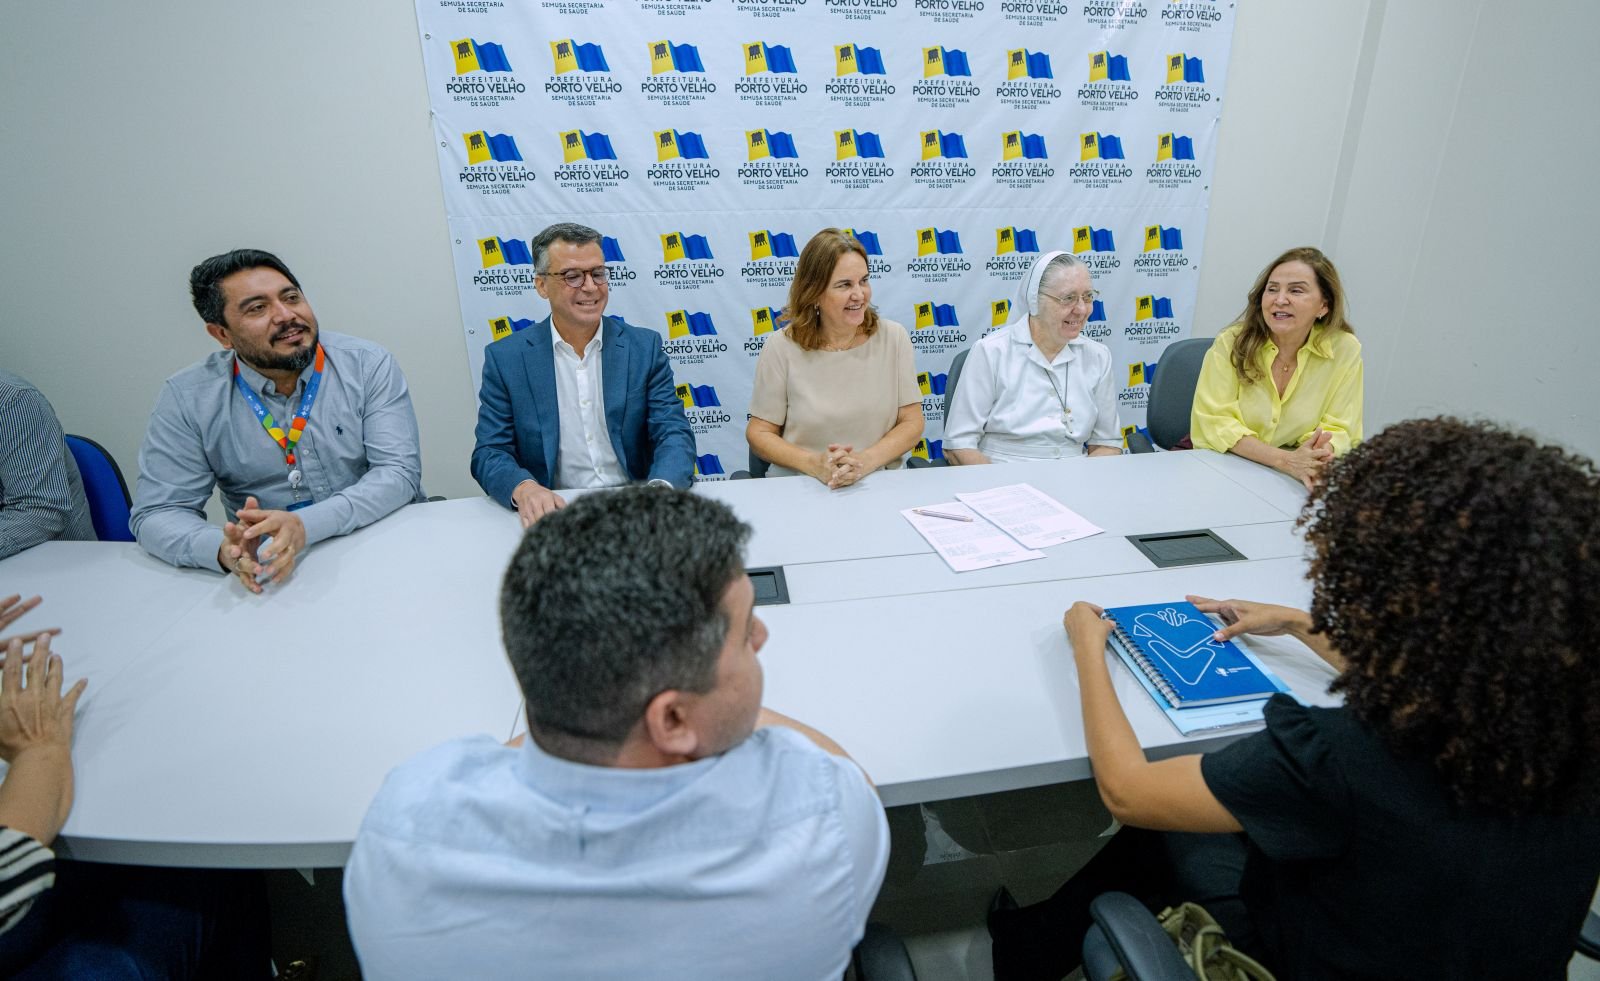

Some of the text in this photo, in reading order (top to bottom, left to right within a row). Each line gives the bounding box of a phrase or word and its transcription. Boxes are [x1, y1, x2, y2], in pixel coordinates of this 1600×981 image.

[863, 0, 898, 8] VELHO
[914, 0, 984, 11] PORTO VELHO
[1000, 2, 1067, 15] PORTO VELHO
[1083, 6, 1116, 17] PORTO
[1161, 10, 1222, 22] PORTO VELHO
[446, 83, 526, 93] PORTO VELHO
[545, 83, 622, 93] PORTO VELHO
[641, 83, 717, 93] PORTO VELHO
[734, 83, 808, 94] PORTO VELHO
[825, 84, 896, 95] PORTO VELHO
[912, 86, 980, 96] PORTO VELHO
[995, 88, 1060, 98] PORTO VELHO
[1078, 89, 1138, 100] PORTO VELHO
[1156, 91, 1211, 102] PORTO VELHO
[459, 171, 536, 182] PORTO VELHO
[554, 170, 629, 180] PORTO VELHO
[647, 169, 720, 179] PORTO VELHO
[737, 168, 808, 178] PORTO VELHO
[825, 168, 894, 177] PORTO VELHO
[909, 168, 976, 177] PORTO VELHO
[992, 168, 1054, 177] PORTO VELHO
[1068, 168, 1132, 177] PORTO VELHO
[1145, 169, 1200, 177] PORTO VELHO
[906, 262, 970, 272] PORTO VELHO
[985, 262, 1015, 270] PORTO
[1095, 260, 1121, 269] VELHO
[1134, 258, 1190, 267] PORTO VELHO
[653, 268, 724, 279] PORTO VELHO
[741, 266, 797, 276] PORTO VEL
[868, 264, 892, 273] ELHO
[473, 274, 535, 285] PORTO VEL
[610, 271, 636, 280] ELHO
[1086, 328, 1112, 337] VELHO
[910, 334, 967, 344] ORTO VELHO
[695, 343, 728, 353] VELHO
[744, 342, 764, 351] POR
[1118, 392, 1144, 400] PORTO
[699, 414, 731, 424] VELHO
